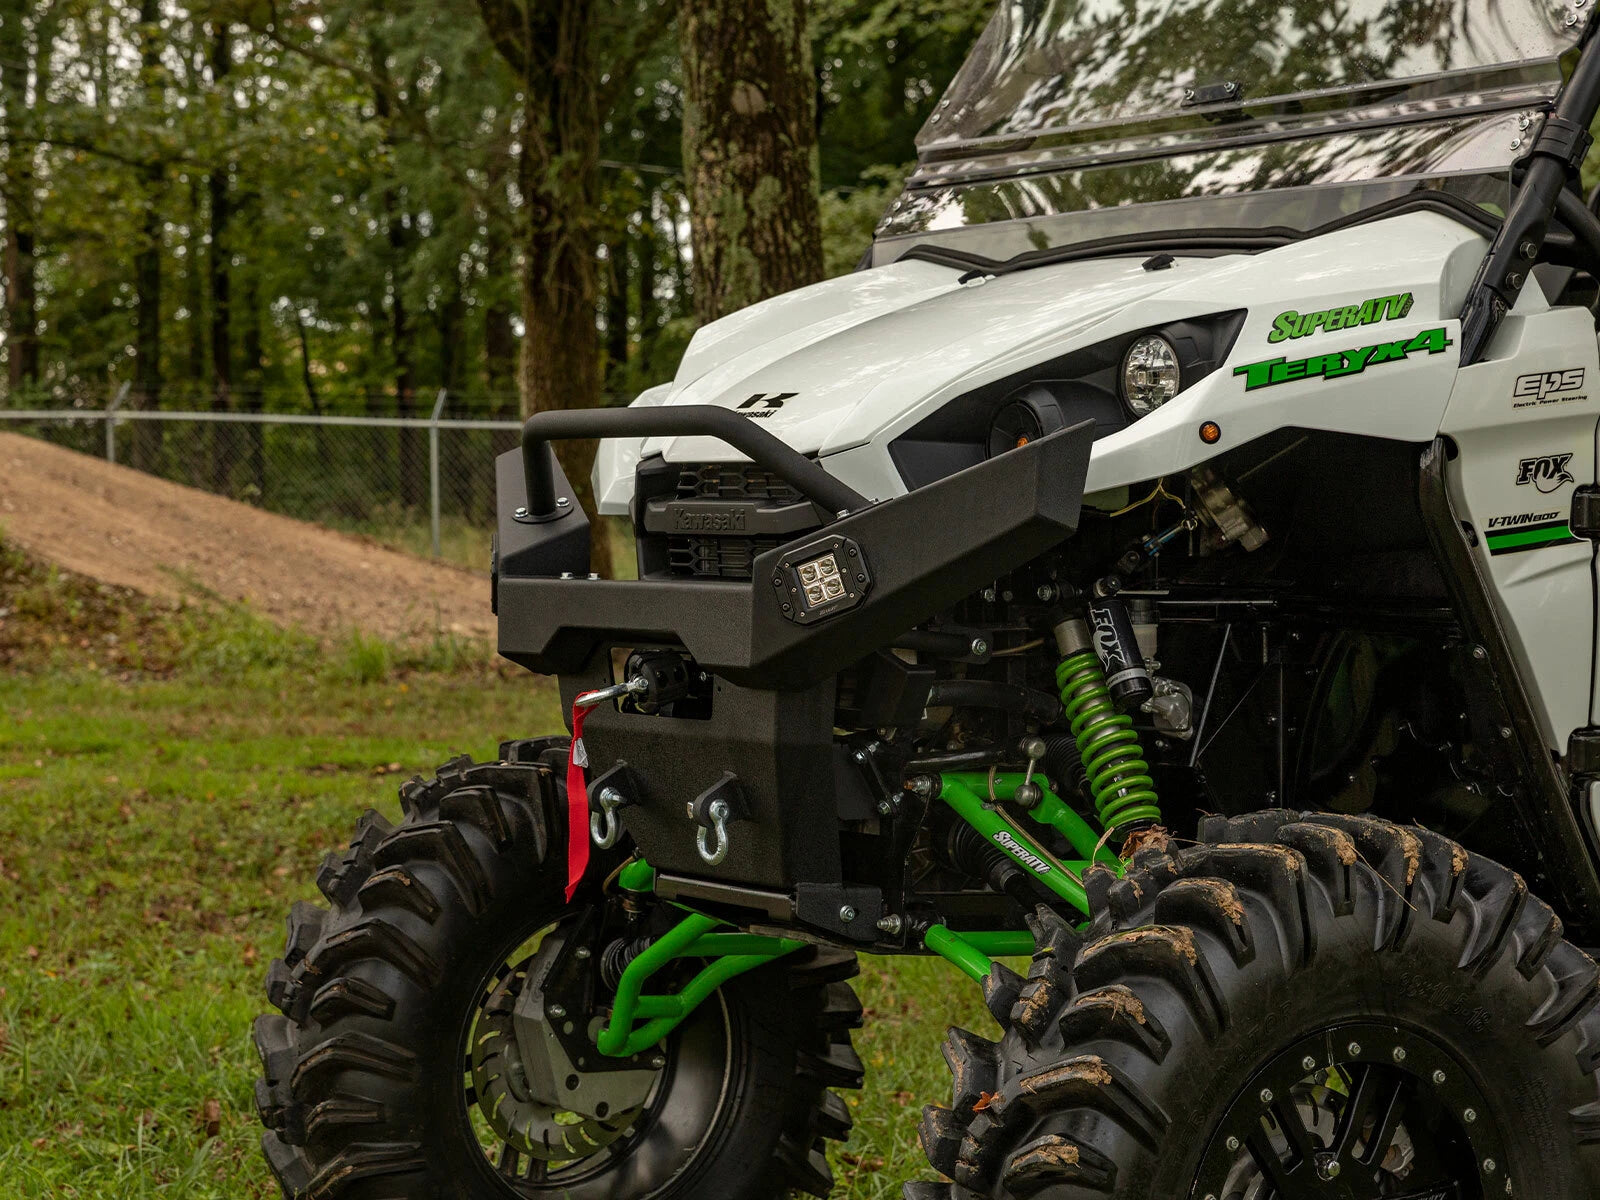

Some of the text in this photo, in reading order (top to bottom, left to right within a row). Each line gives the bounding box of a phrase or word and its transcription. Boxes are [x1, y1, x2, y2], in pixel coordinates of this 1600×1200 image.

[1233, 327, 1453, 392] TERYX4
[1516, 453, 1574, 492] FOX
[674, 508, 745, 530] Kawasaki
[1090, 608, 1127, 672] FOX
